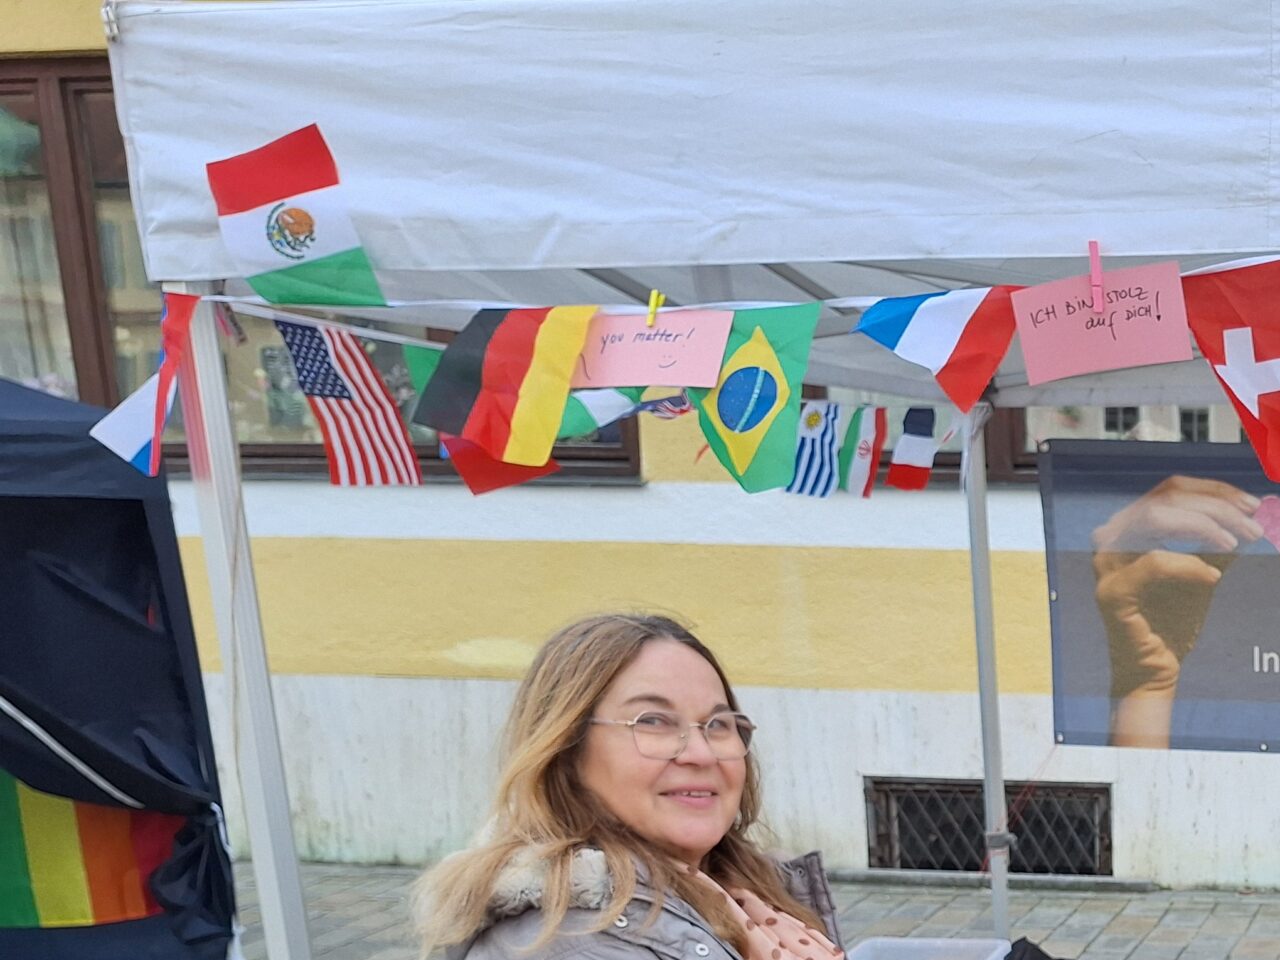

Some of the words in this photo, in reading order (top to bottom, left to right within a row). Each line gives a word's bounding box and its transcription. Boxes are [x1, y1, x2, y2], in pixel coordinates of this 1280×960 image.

[1030, 304, 1058, 329] ICH
[1106, 286, 1150, 304] STOLZ
[632, 327, 695, 348] matter!
[1085, 311, 1117, 341] auf
